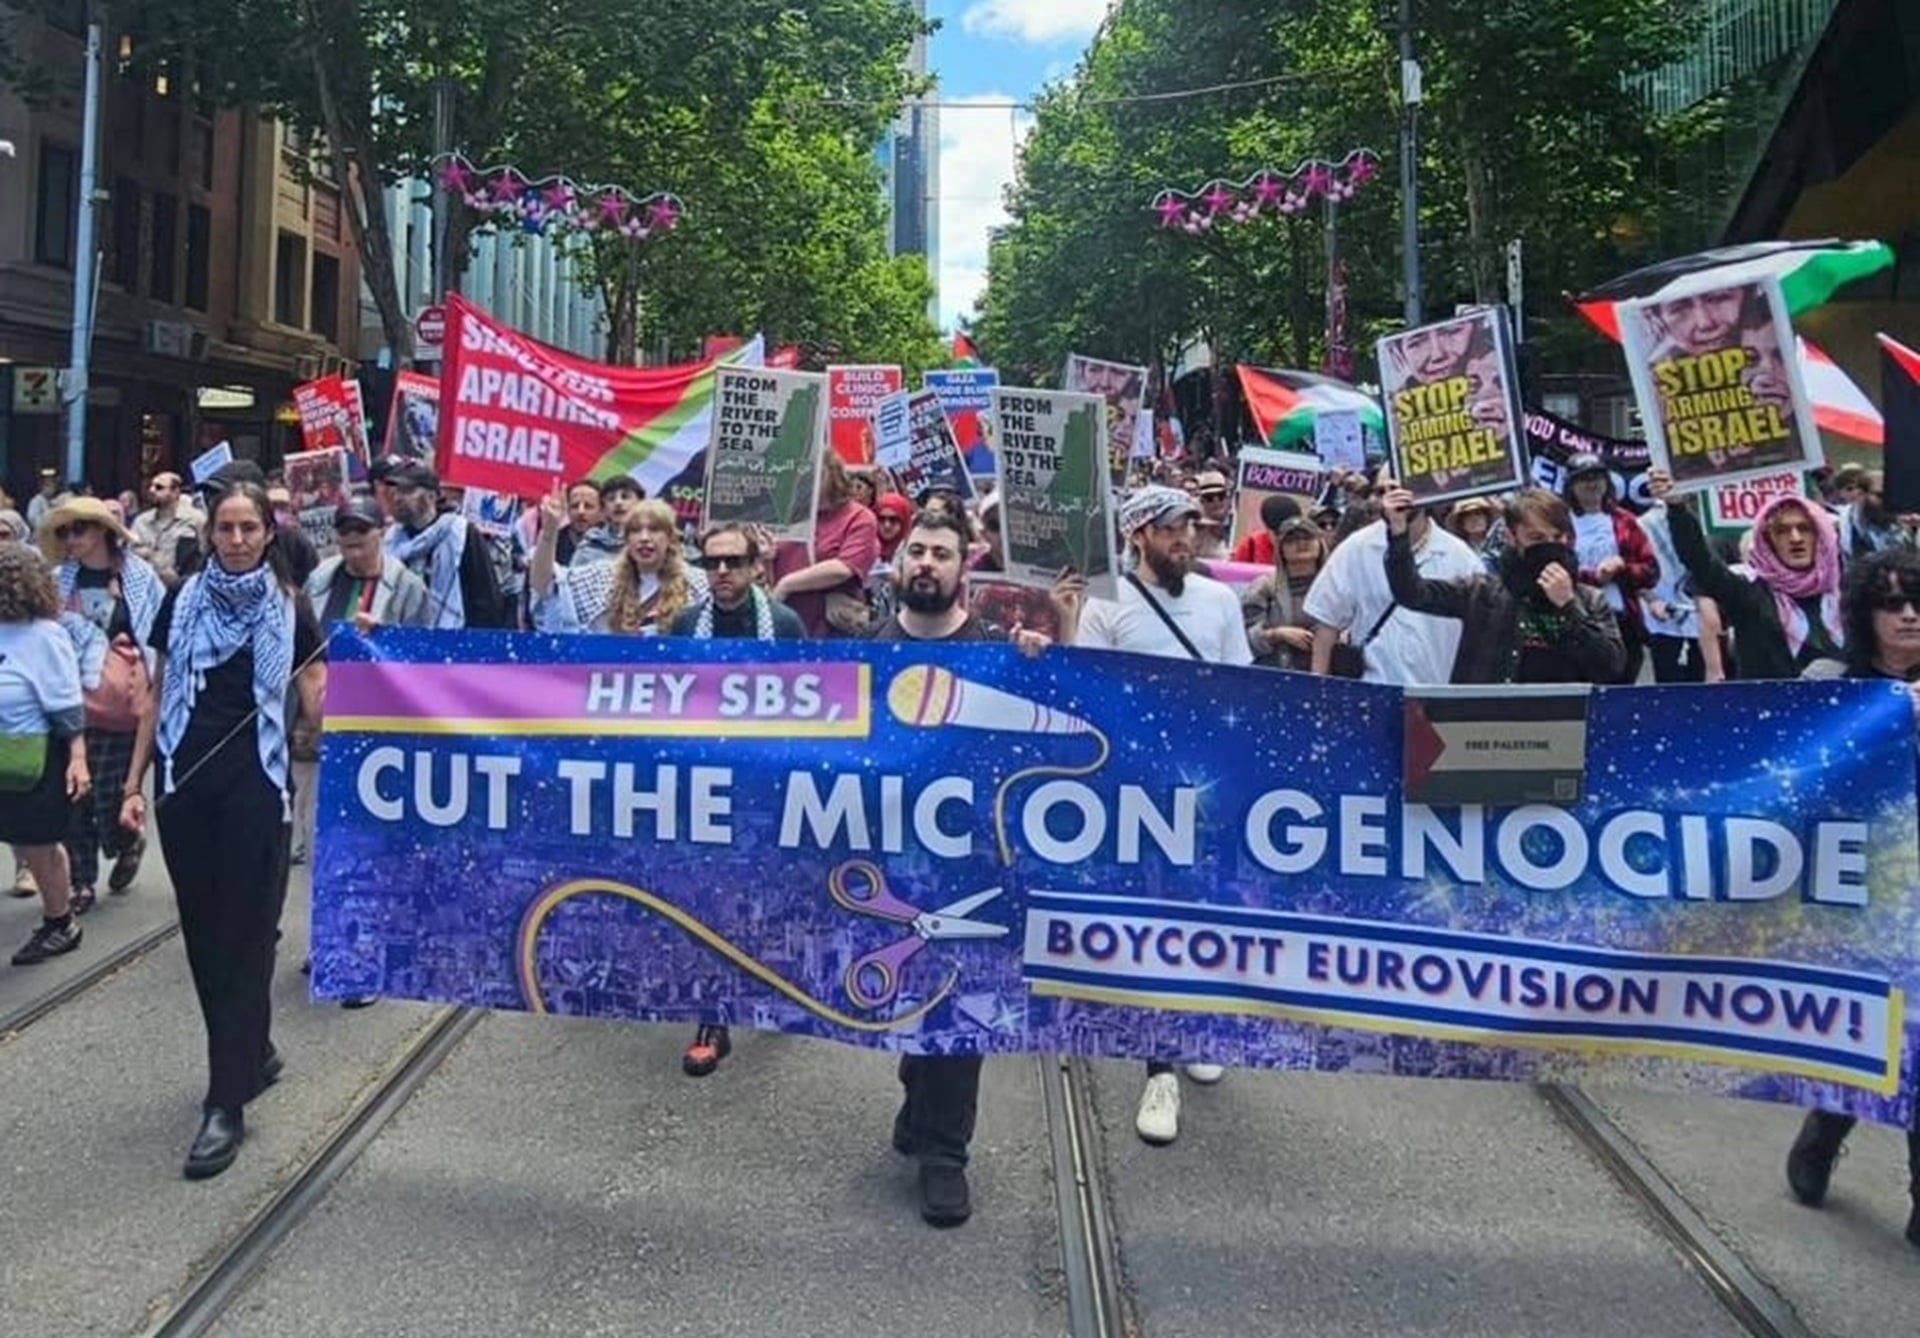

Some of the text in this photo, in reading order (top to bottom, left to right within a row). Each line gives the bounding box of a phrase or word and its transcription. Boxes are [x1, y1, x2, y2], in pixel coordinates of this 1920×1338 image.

[723, 376, 777, 392] FROM
[1654, 347, 1746, 398] STOP
[723, 391, 758, 406] THE
[1001, 397, 1052, 414] FROM
[1393, 376, 1469, 421] STOP
[1666, 386, 1752, 421] ARMING
[721, 406, 778, 422] RIVER
[1002, 415, 1035, 431] THE
[1523, 413, 1555, 440] YOU
[720, 421, 781, 438] TO THE
[1400, 411, 1472, 446] ARMING
[1667, 406, 1790, 458] ISRAEL
[455, 416, 566, 473] ISRAEL
[719, 437, 753, 451] SEA
[1003, 433, 1056, 452] RIVER
[1400, 429, 1505, 478] ISRAEL
[1004, 452, 1064, 471] TO THE
[1006, 470, 1036, 487] SEA
[1246, 466, 1315, 491] BOYCOTT
[586, 673, 842, 723] HEY SBS,
[1465, 740, 1550, 751] FREE PALESTINE
[357, 746, 1870, 905] CUT THE MIC ON GENOCIDE
[1046, 919, 1865, 1042] BOYCOTT EUROVISION NOW!
